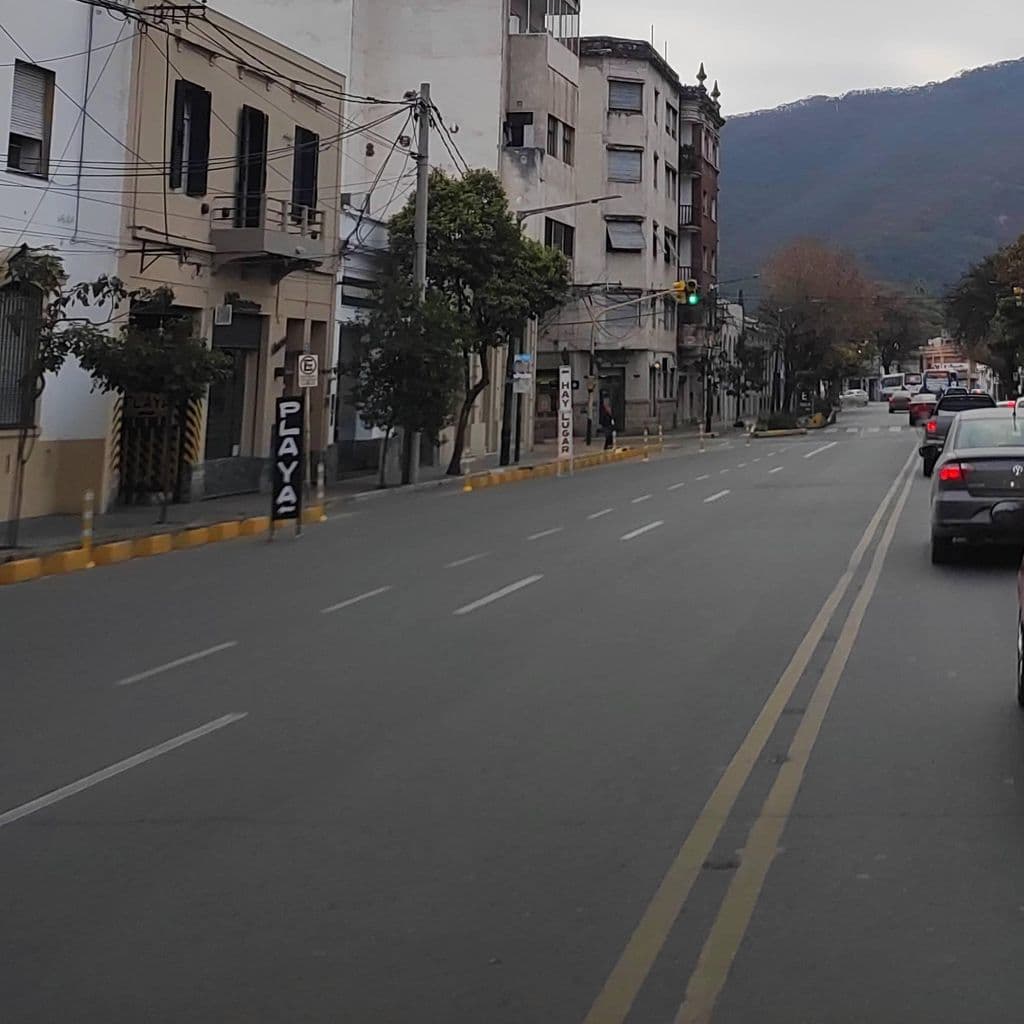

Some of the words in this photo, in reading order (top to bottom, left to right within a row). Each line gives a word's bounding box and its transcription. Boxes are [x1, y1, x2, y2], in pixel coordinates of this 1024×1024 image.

[303, 359, 313, 372] E
[561, 382, 570, 407] HAY
[561, 414, 570, 453] LUGAR
[276, 401, 300, 504] PLAYA
